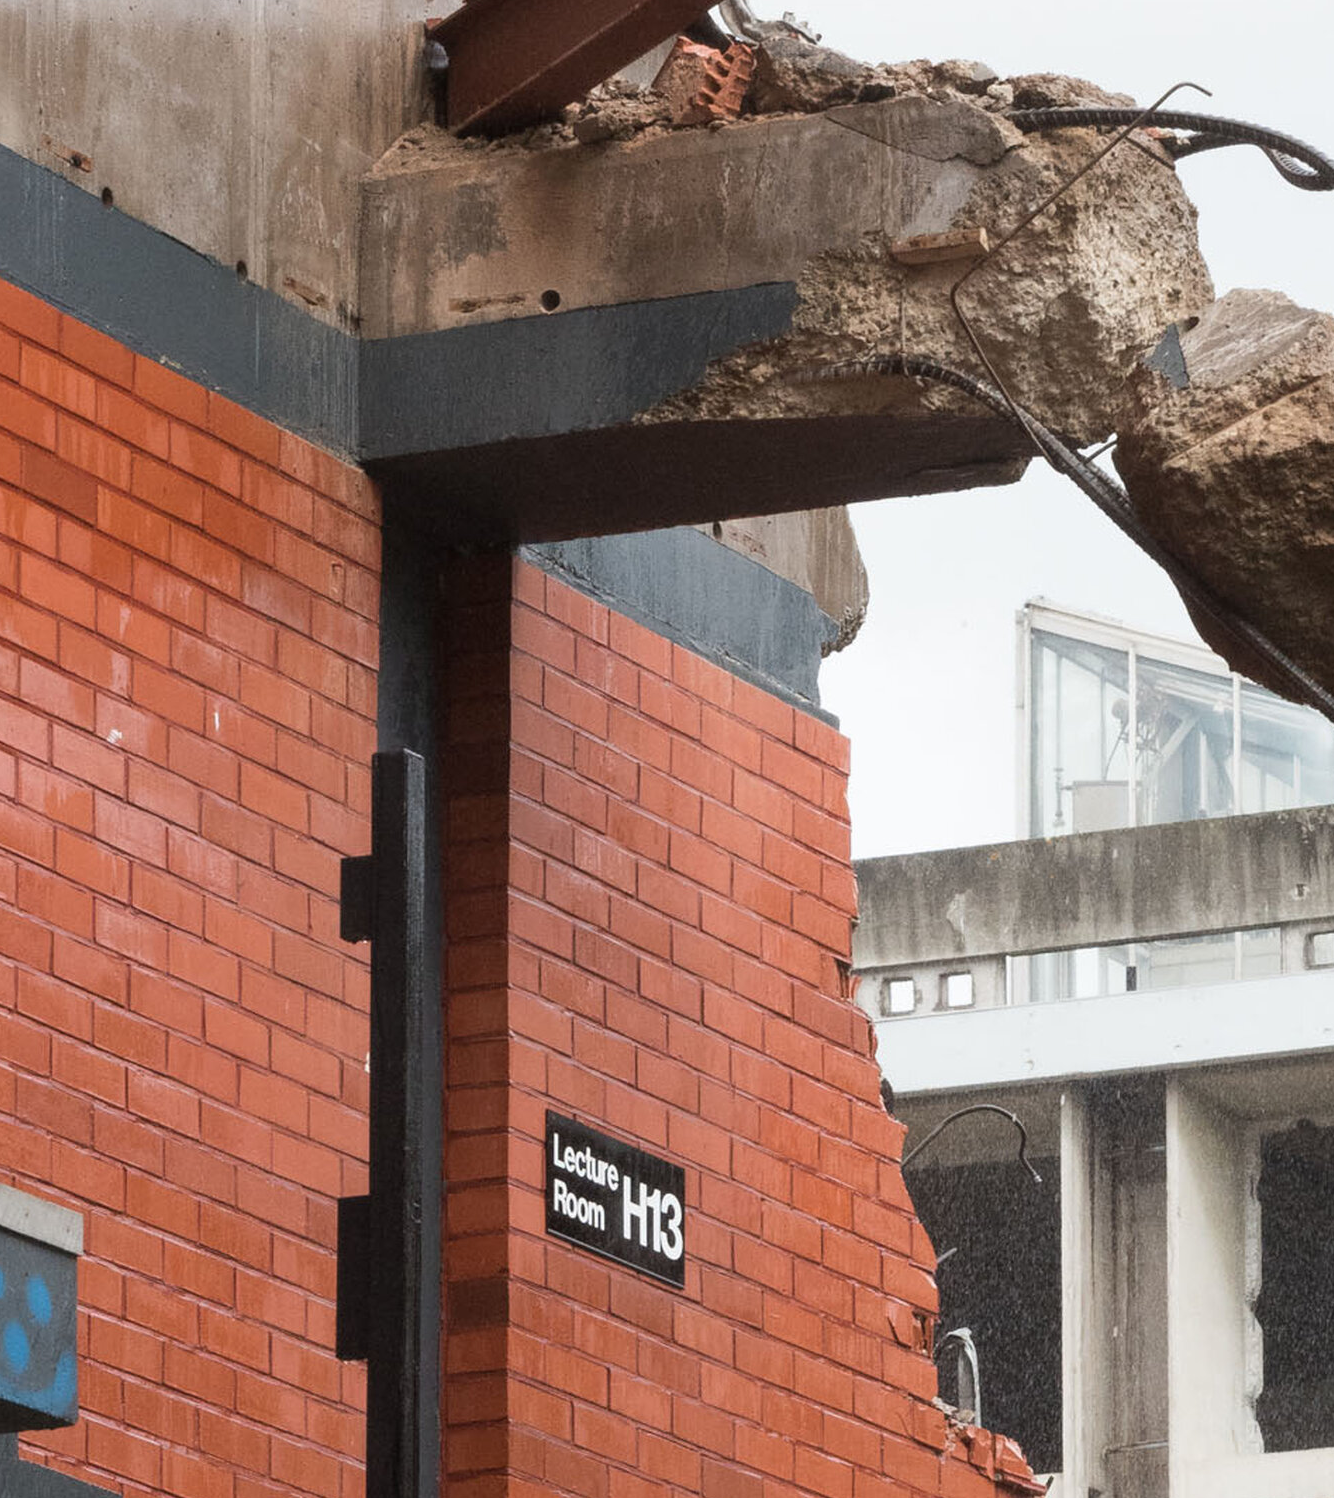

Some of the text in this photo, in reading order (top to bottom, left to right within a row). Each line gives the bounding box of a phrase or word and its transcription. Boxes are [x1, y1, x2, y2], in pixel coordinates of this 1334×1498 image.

[553, 1132, 620, 1191] Lecture
[553, 1175, 684, 1261] Room H13
